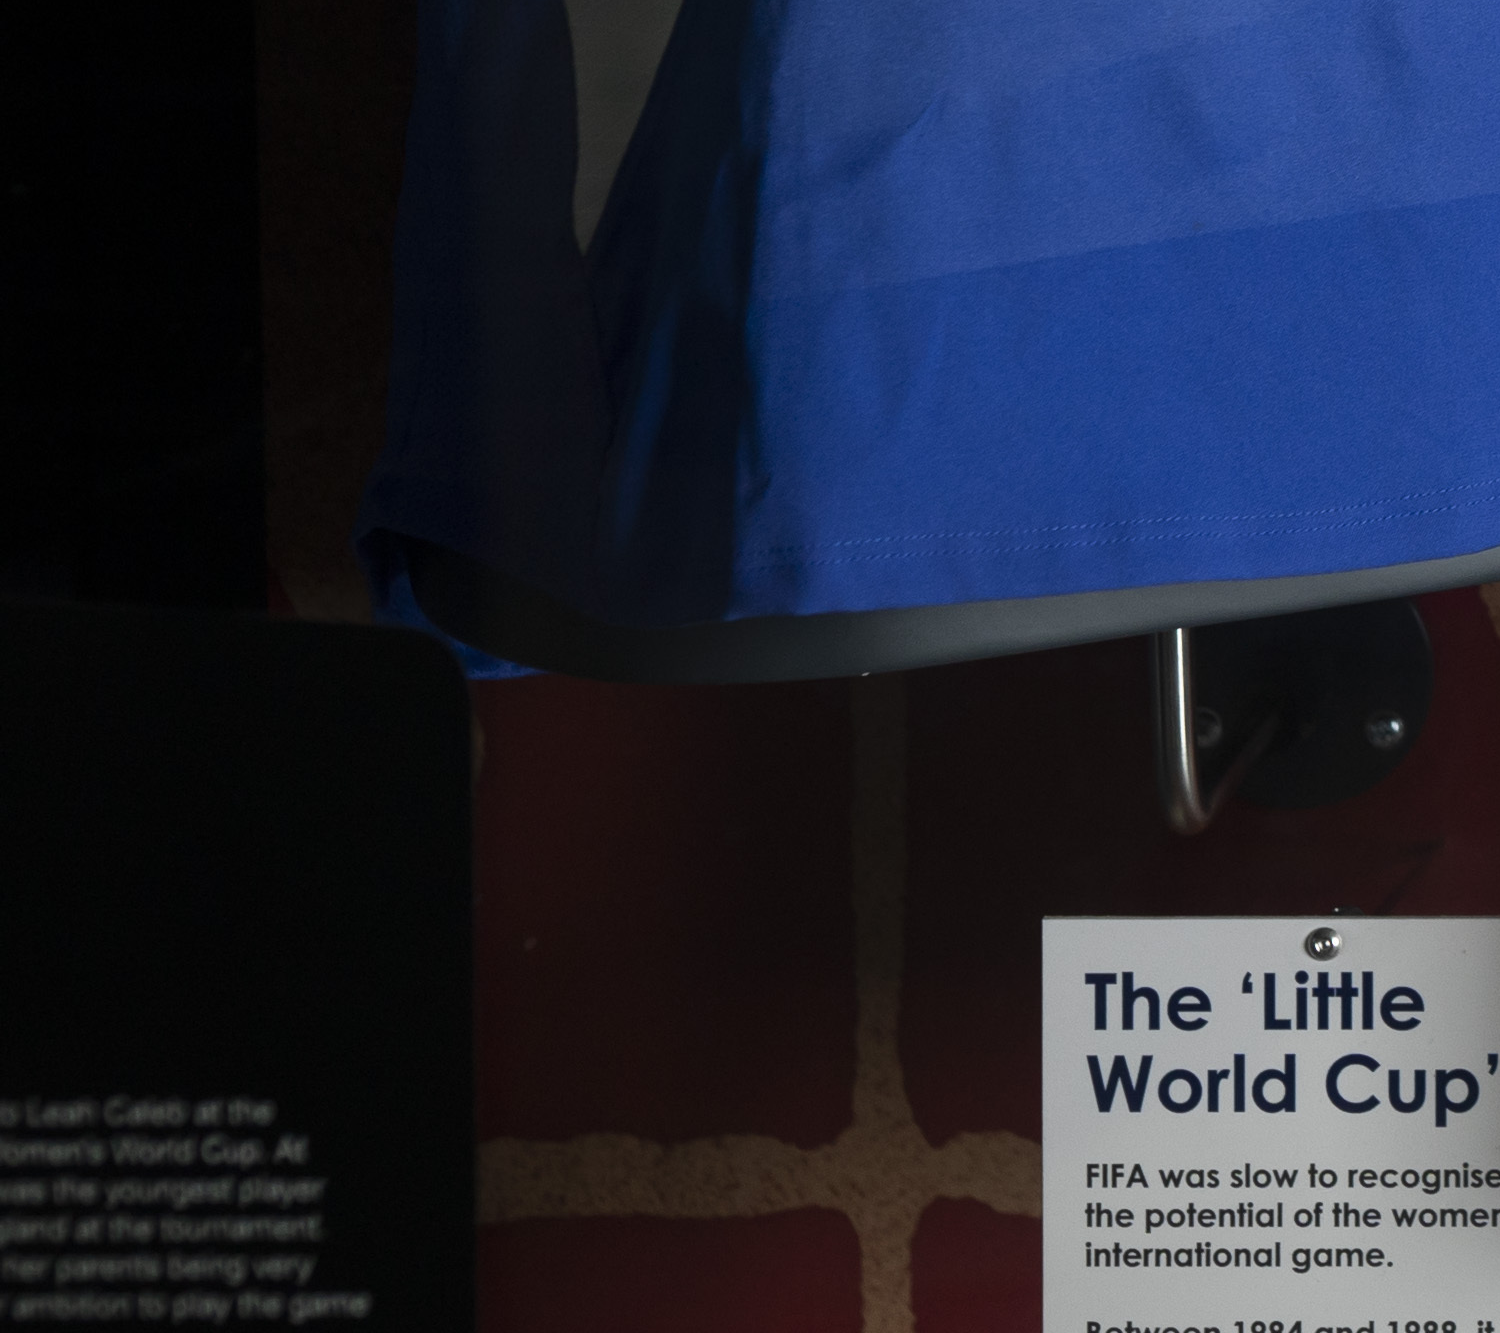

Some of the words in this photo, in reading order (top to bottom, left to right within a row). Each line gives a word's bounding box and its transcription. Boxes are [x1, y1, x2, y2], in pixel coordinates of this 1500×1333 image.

[1085, 972, 1212, 1031] The
[1242, 970, 1425, 1031] ‘Little
[1086, 1054, 1296, 1113] World
[1326, 1053, 1498, 1127] Cup’
[1087, 1164, 1149, 1188] FIFA
[1159, 1169, 1219, 1188] was
[1230, 1163, 1298, 1188] slow
[1308, 1163, 1337, 1188] to
[1085, 1203, 1134, 1228] the
[1146, 1202, 1283, 1233] potential
[1294, 1202, 1323, 1227] of
[1332, 1202, 1381, 1227] the
[1086, 1241, 1281, 1267] international
[1292, 1247, 1394, 1273] game.
